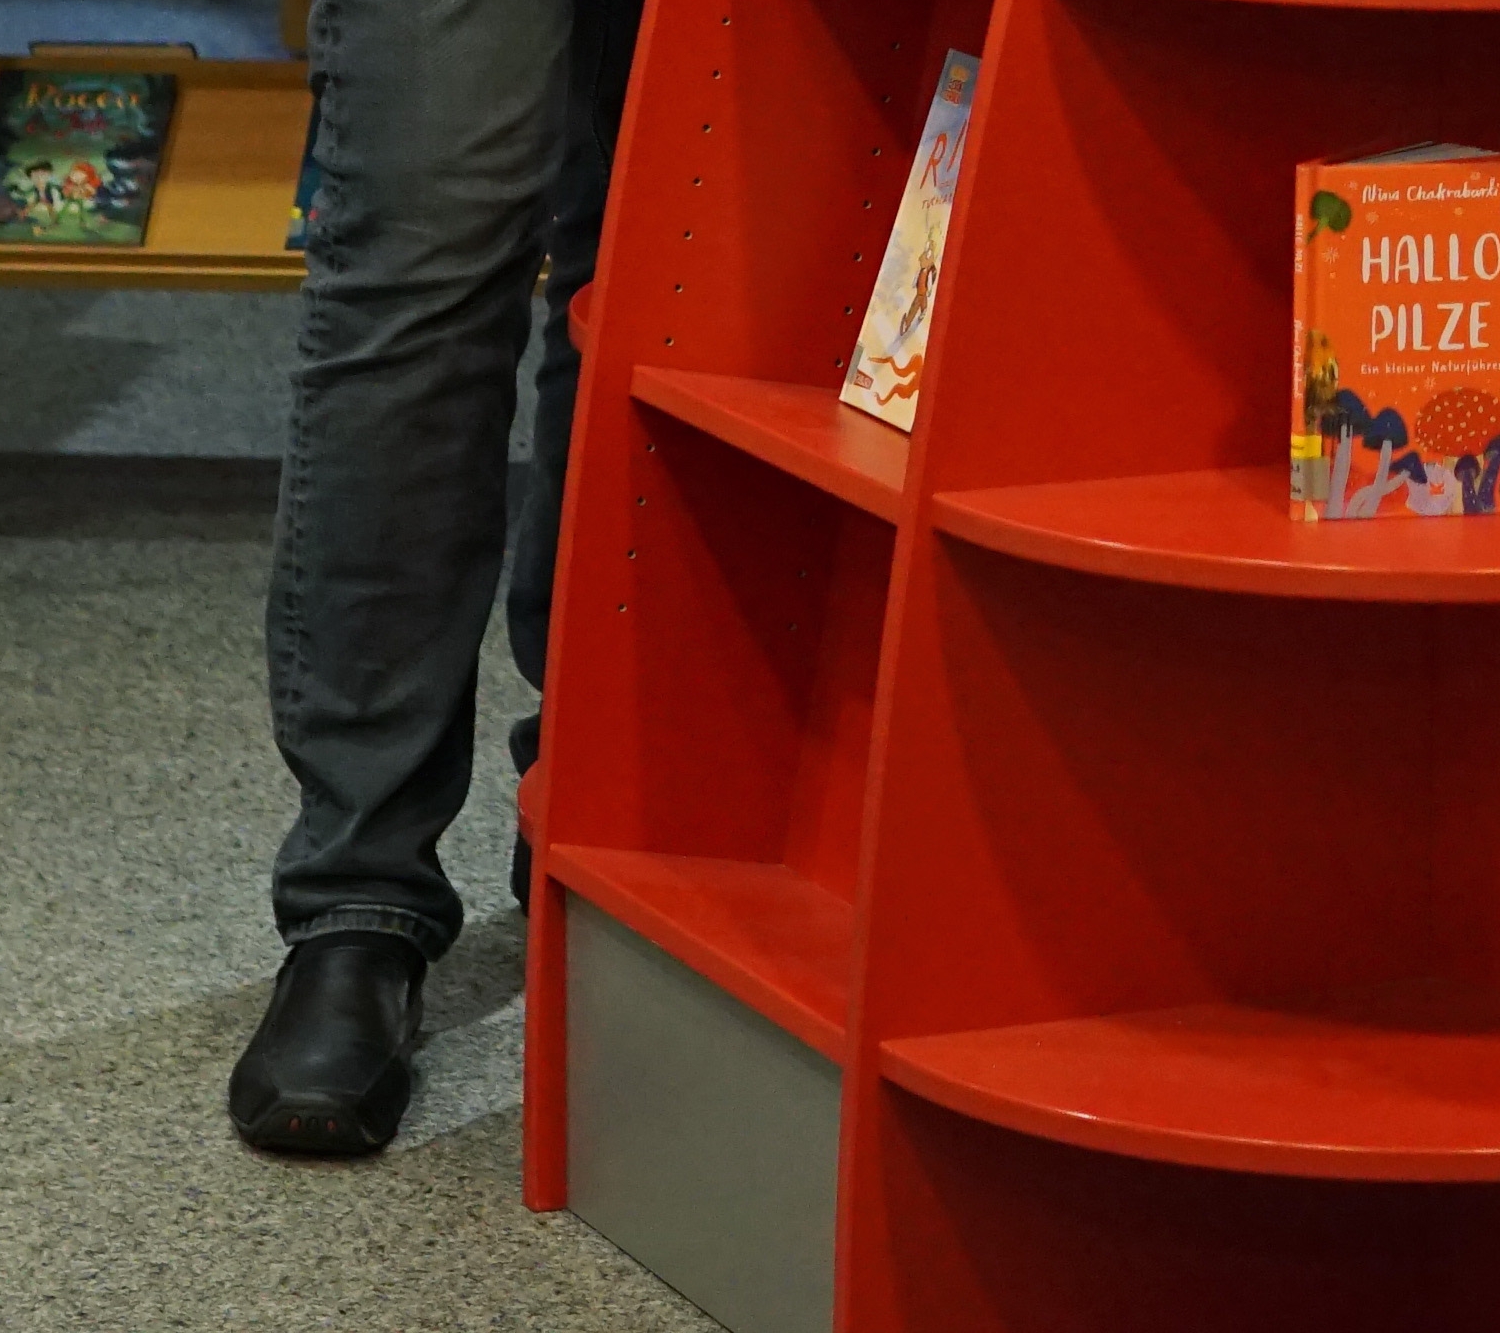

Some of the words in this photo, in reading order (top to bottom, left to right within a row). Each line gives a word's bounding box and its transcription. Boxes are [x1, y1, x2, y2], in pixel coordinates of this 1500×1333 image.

[1371, 301, 1491, 353] PILZE
[1360, 364, 1380, 376] Ein
[1385, 361, 1427, 374] kleiner
